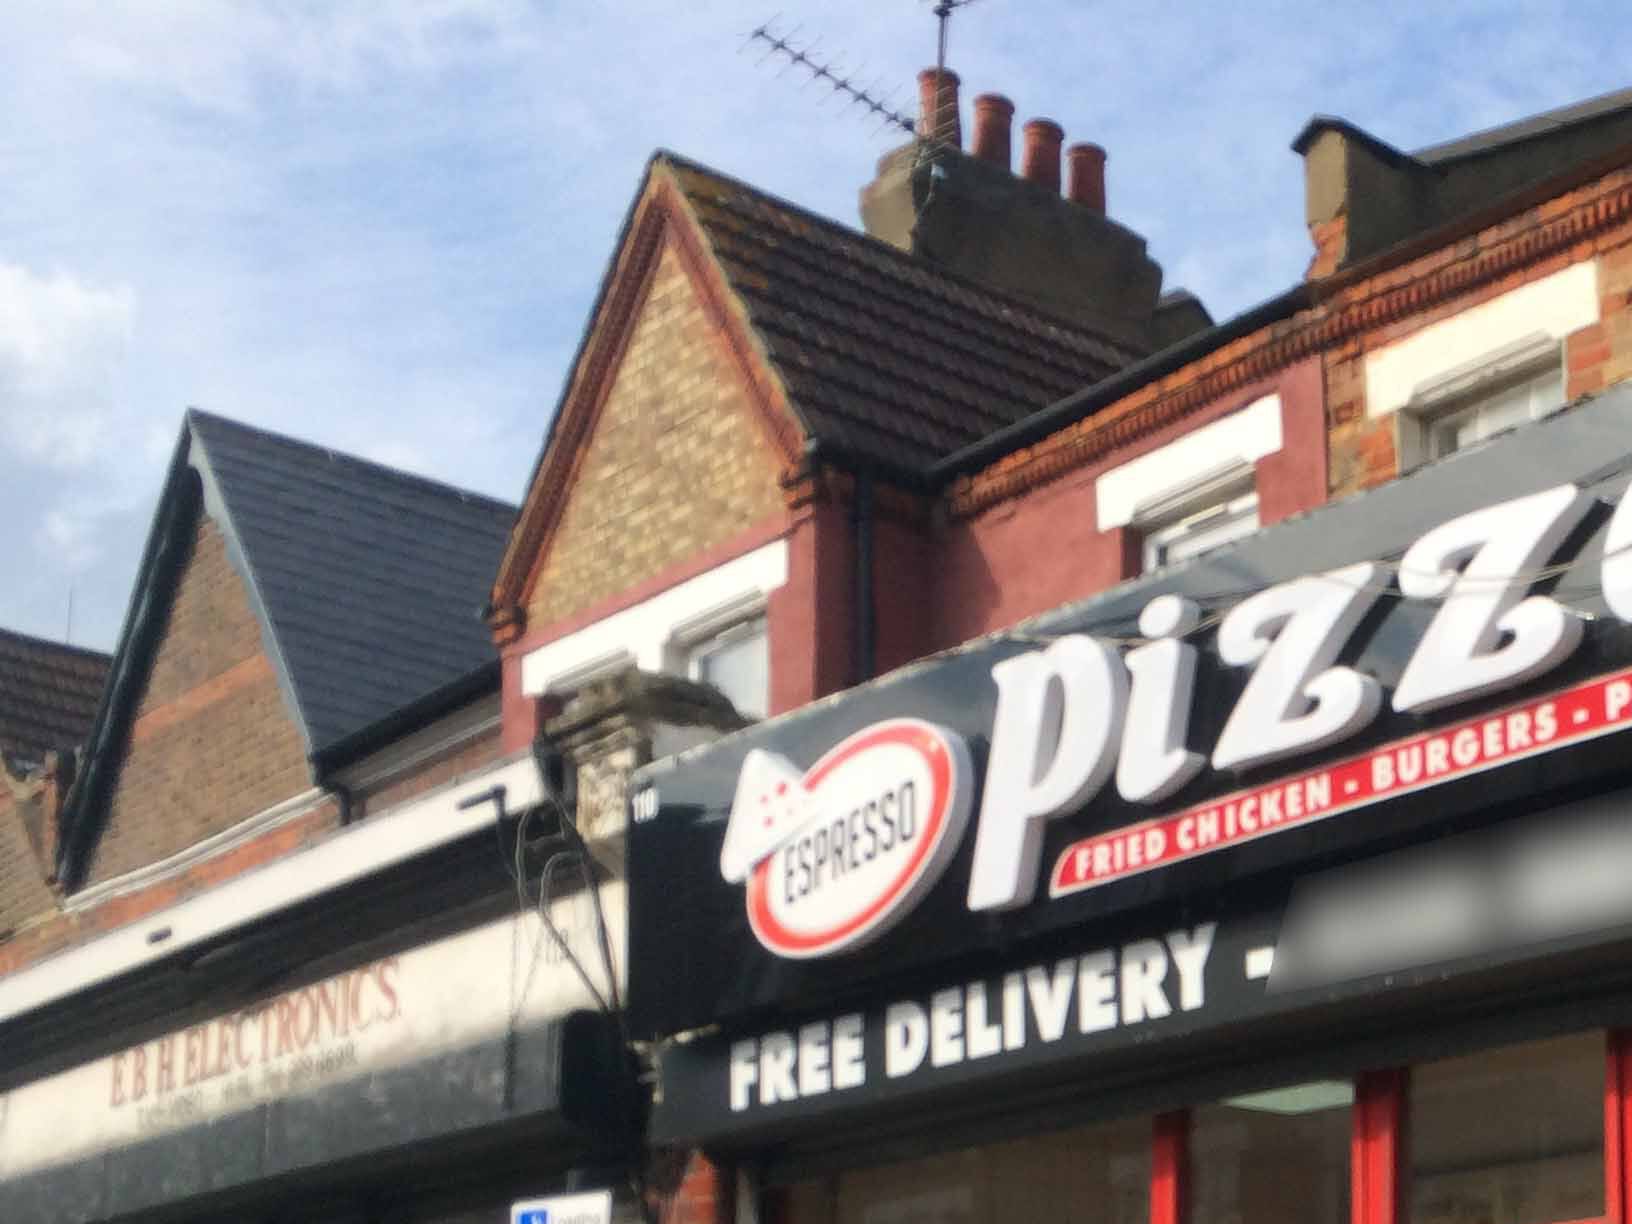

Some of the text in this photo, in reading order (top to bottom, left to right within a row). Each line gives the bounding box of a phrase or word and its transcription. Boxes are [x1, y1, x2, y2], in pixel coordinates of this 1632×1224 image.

[783, 779, 917, 905] ESPRESSO
[1074, 831, 1165, 881] FRIED
[1176, 772, 1332, 853] CHICKEN
[1370, 704, 1557, 793] BURGERS
[182, 956, 401, 1087] ELECTRONICS
[729, 1011, 867, 1112] FREE
[885, 922, 1216, 1080] DELIVERY
